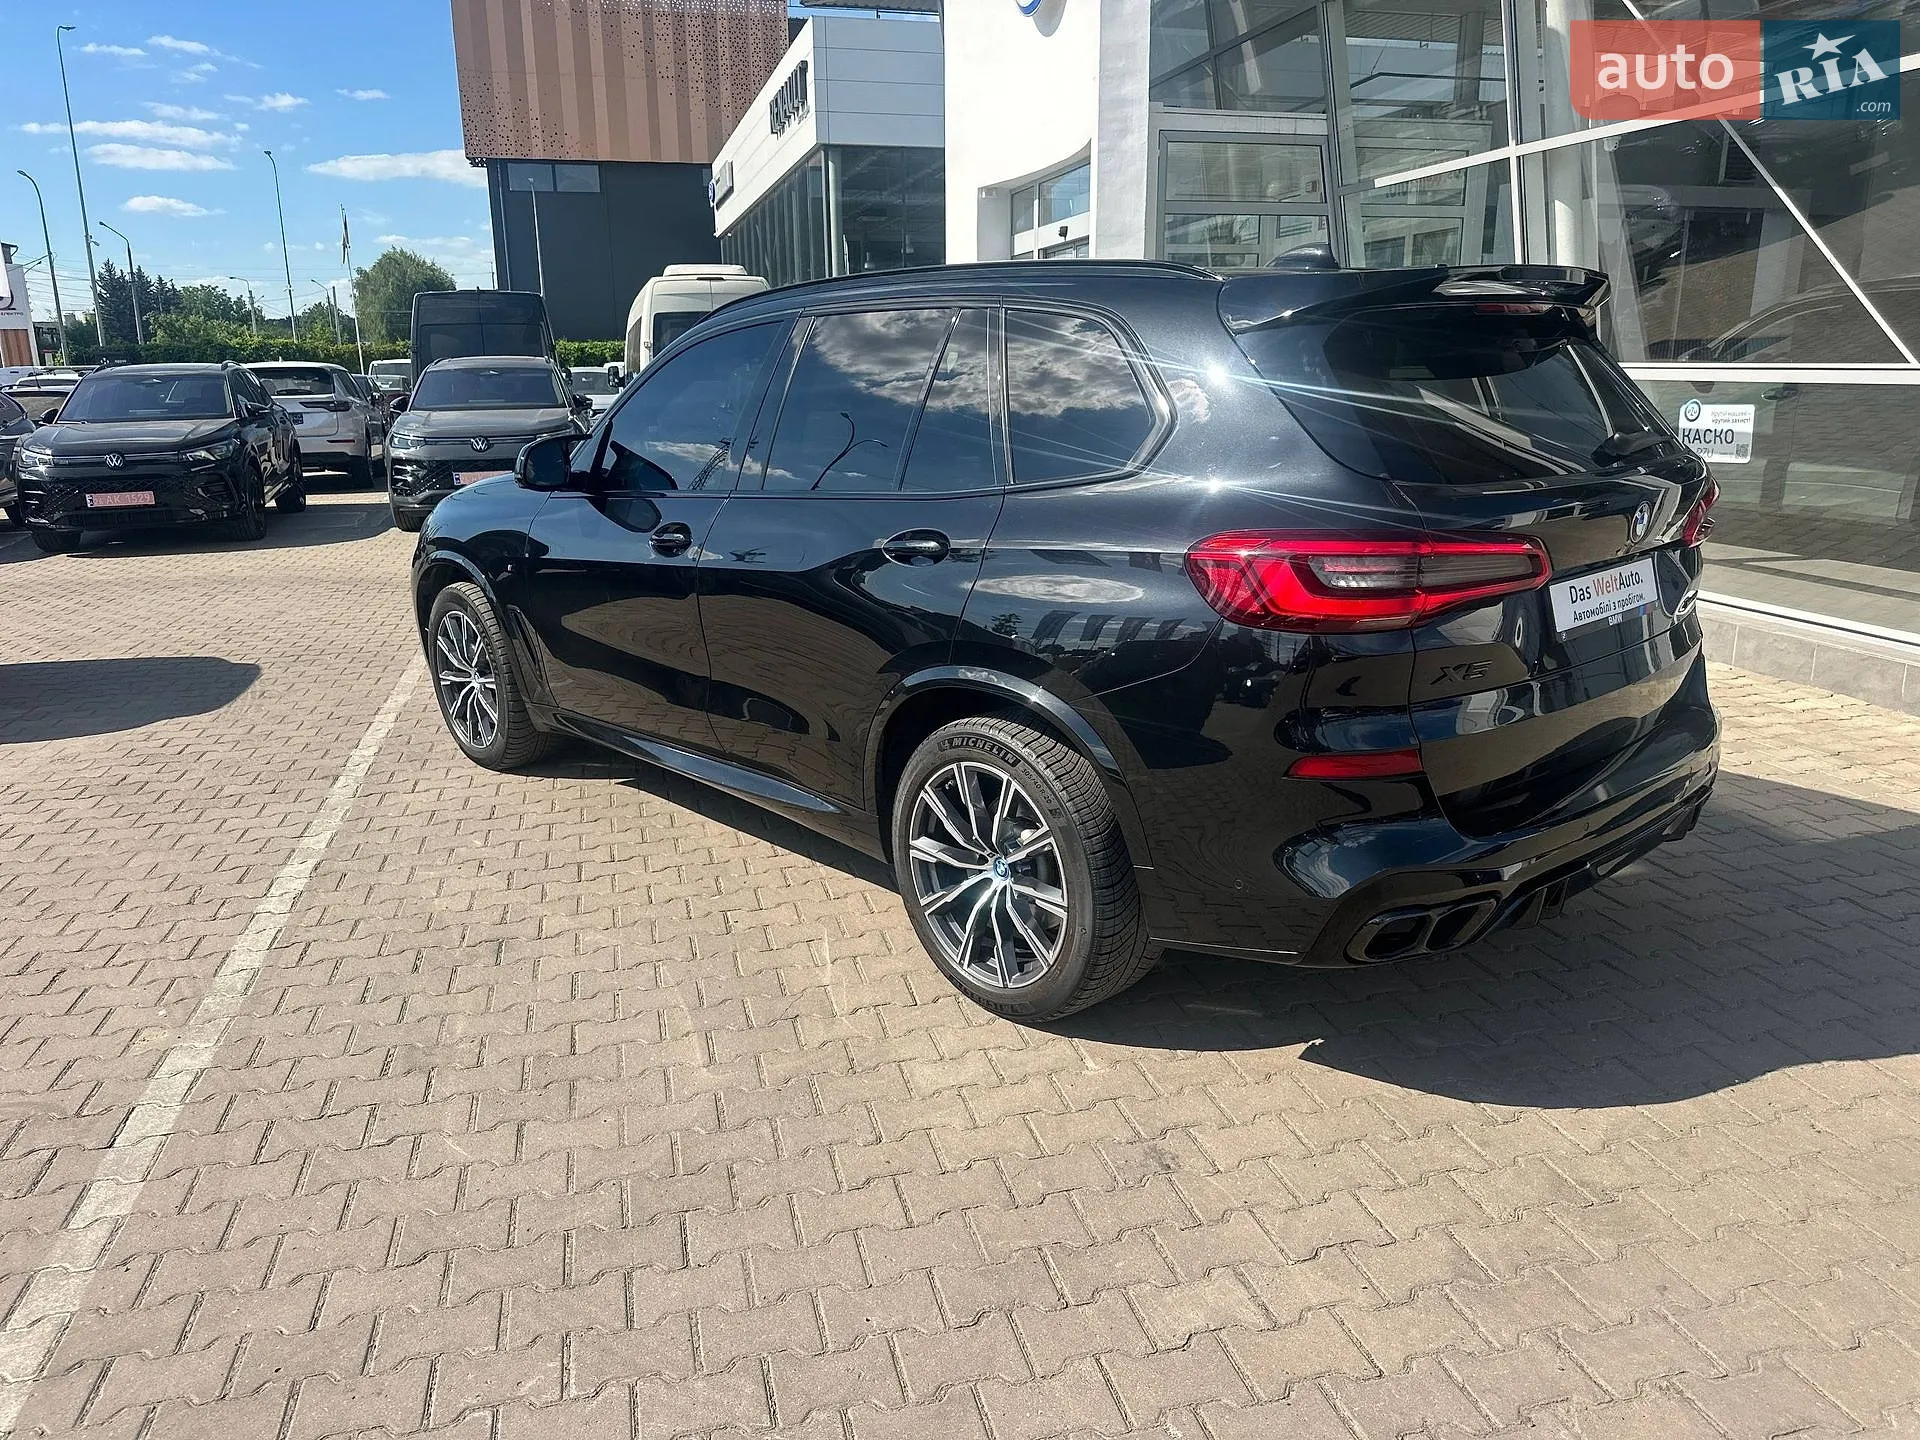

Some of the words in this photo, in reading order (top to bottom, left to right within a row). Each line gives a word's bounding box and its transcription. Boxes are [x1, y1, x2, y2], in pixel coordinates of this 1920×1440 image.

[1682, 428, 1735, 444] КАСКО
[1569, 585, 1592, 605] Das
[1593, 570, 1643, 596] WeltAuto.
[1573, 600, 1612, 623] Автомобілі
[1613, 601, 1617, 611] з
[1617, 592, 1646, 611] пробігом.
[1430, 660, 1493, 685] X5
[952, 737, 1018, 764] MICHELIN
